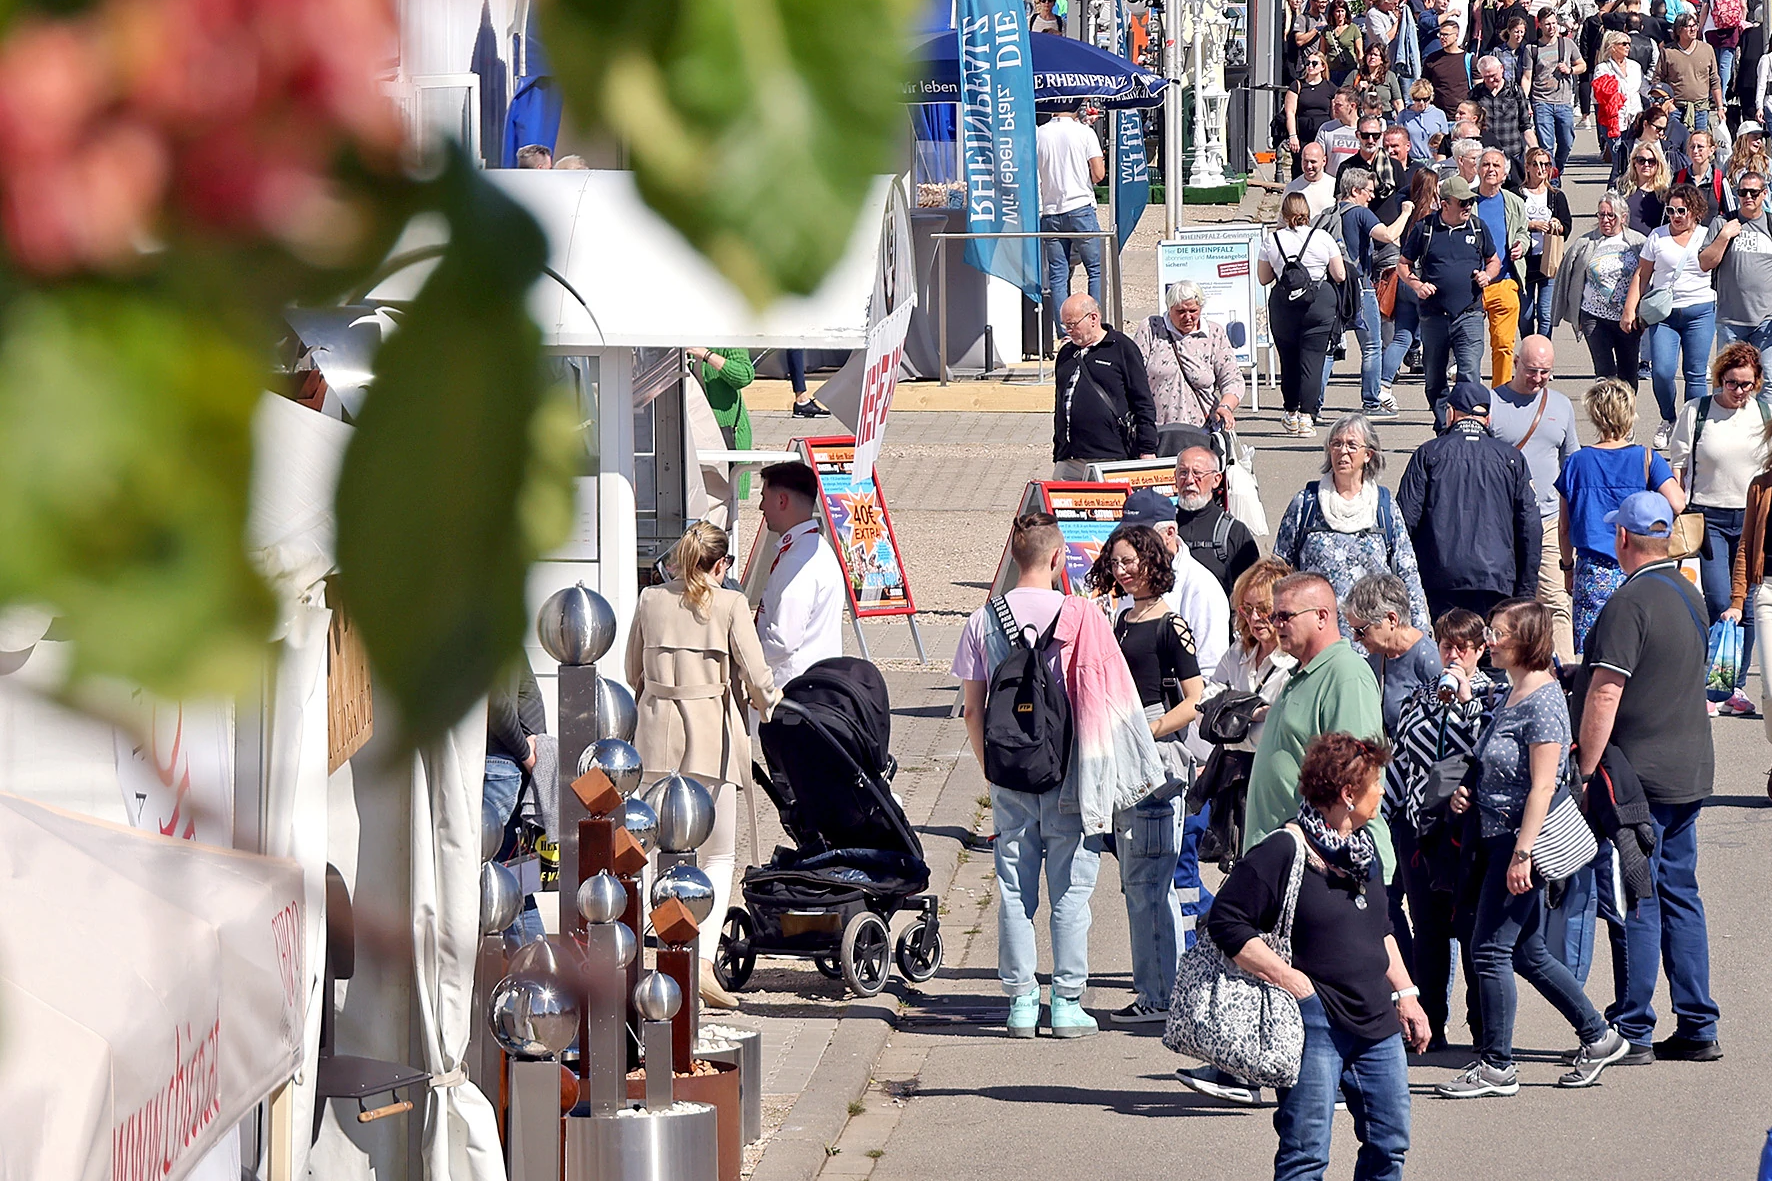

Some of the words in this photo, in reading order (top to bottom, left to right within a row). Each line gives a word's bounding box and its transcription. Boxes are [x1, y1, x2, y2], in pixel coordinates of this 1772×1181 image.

[1047, 71, 1128, 89] RHEINPFALZ
[920, 80, 958, 94] leben
[1180, 231, 1261, 240] RHEINPFALZ-Gewinnspie
[1734, 238, 1756, 246] ORTH
[1191, 246, 1234, 254] RHEINPFALZ
[1206, 253, 1248, 261] Messeangebot
[1131, 475, 1141, 485] auf
[1142, 474, 1153, 484] dem
[1074, 498, 1083, 507] auf
[1084, 498, 1096, 507] dem
[853, 504, 875, 526] 40€
